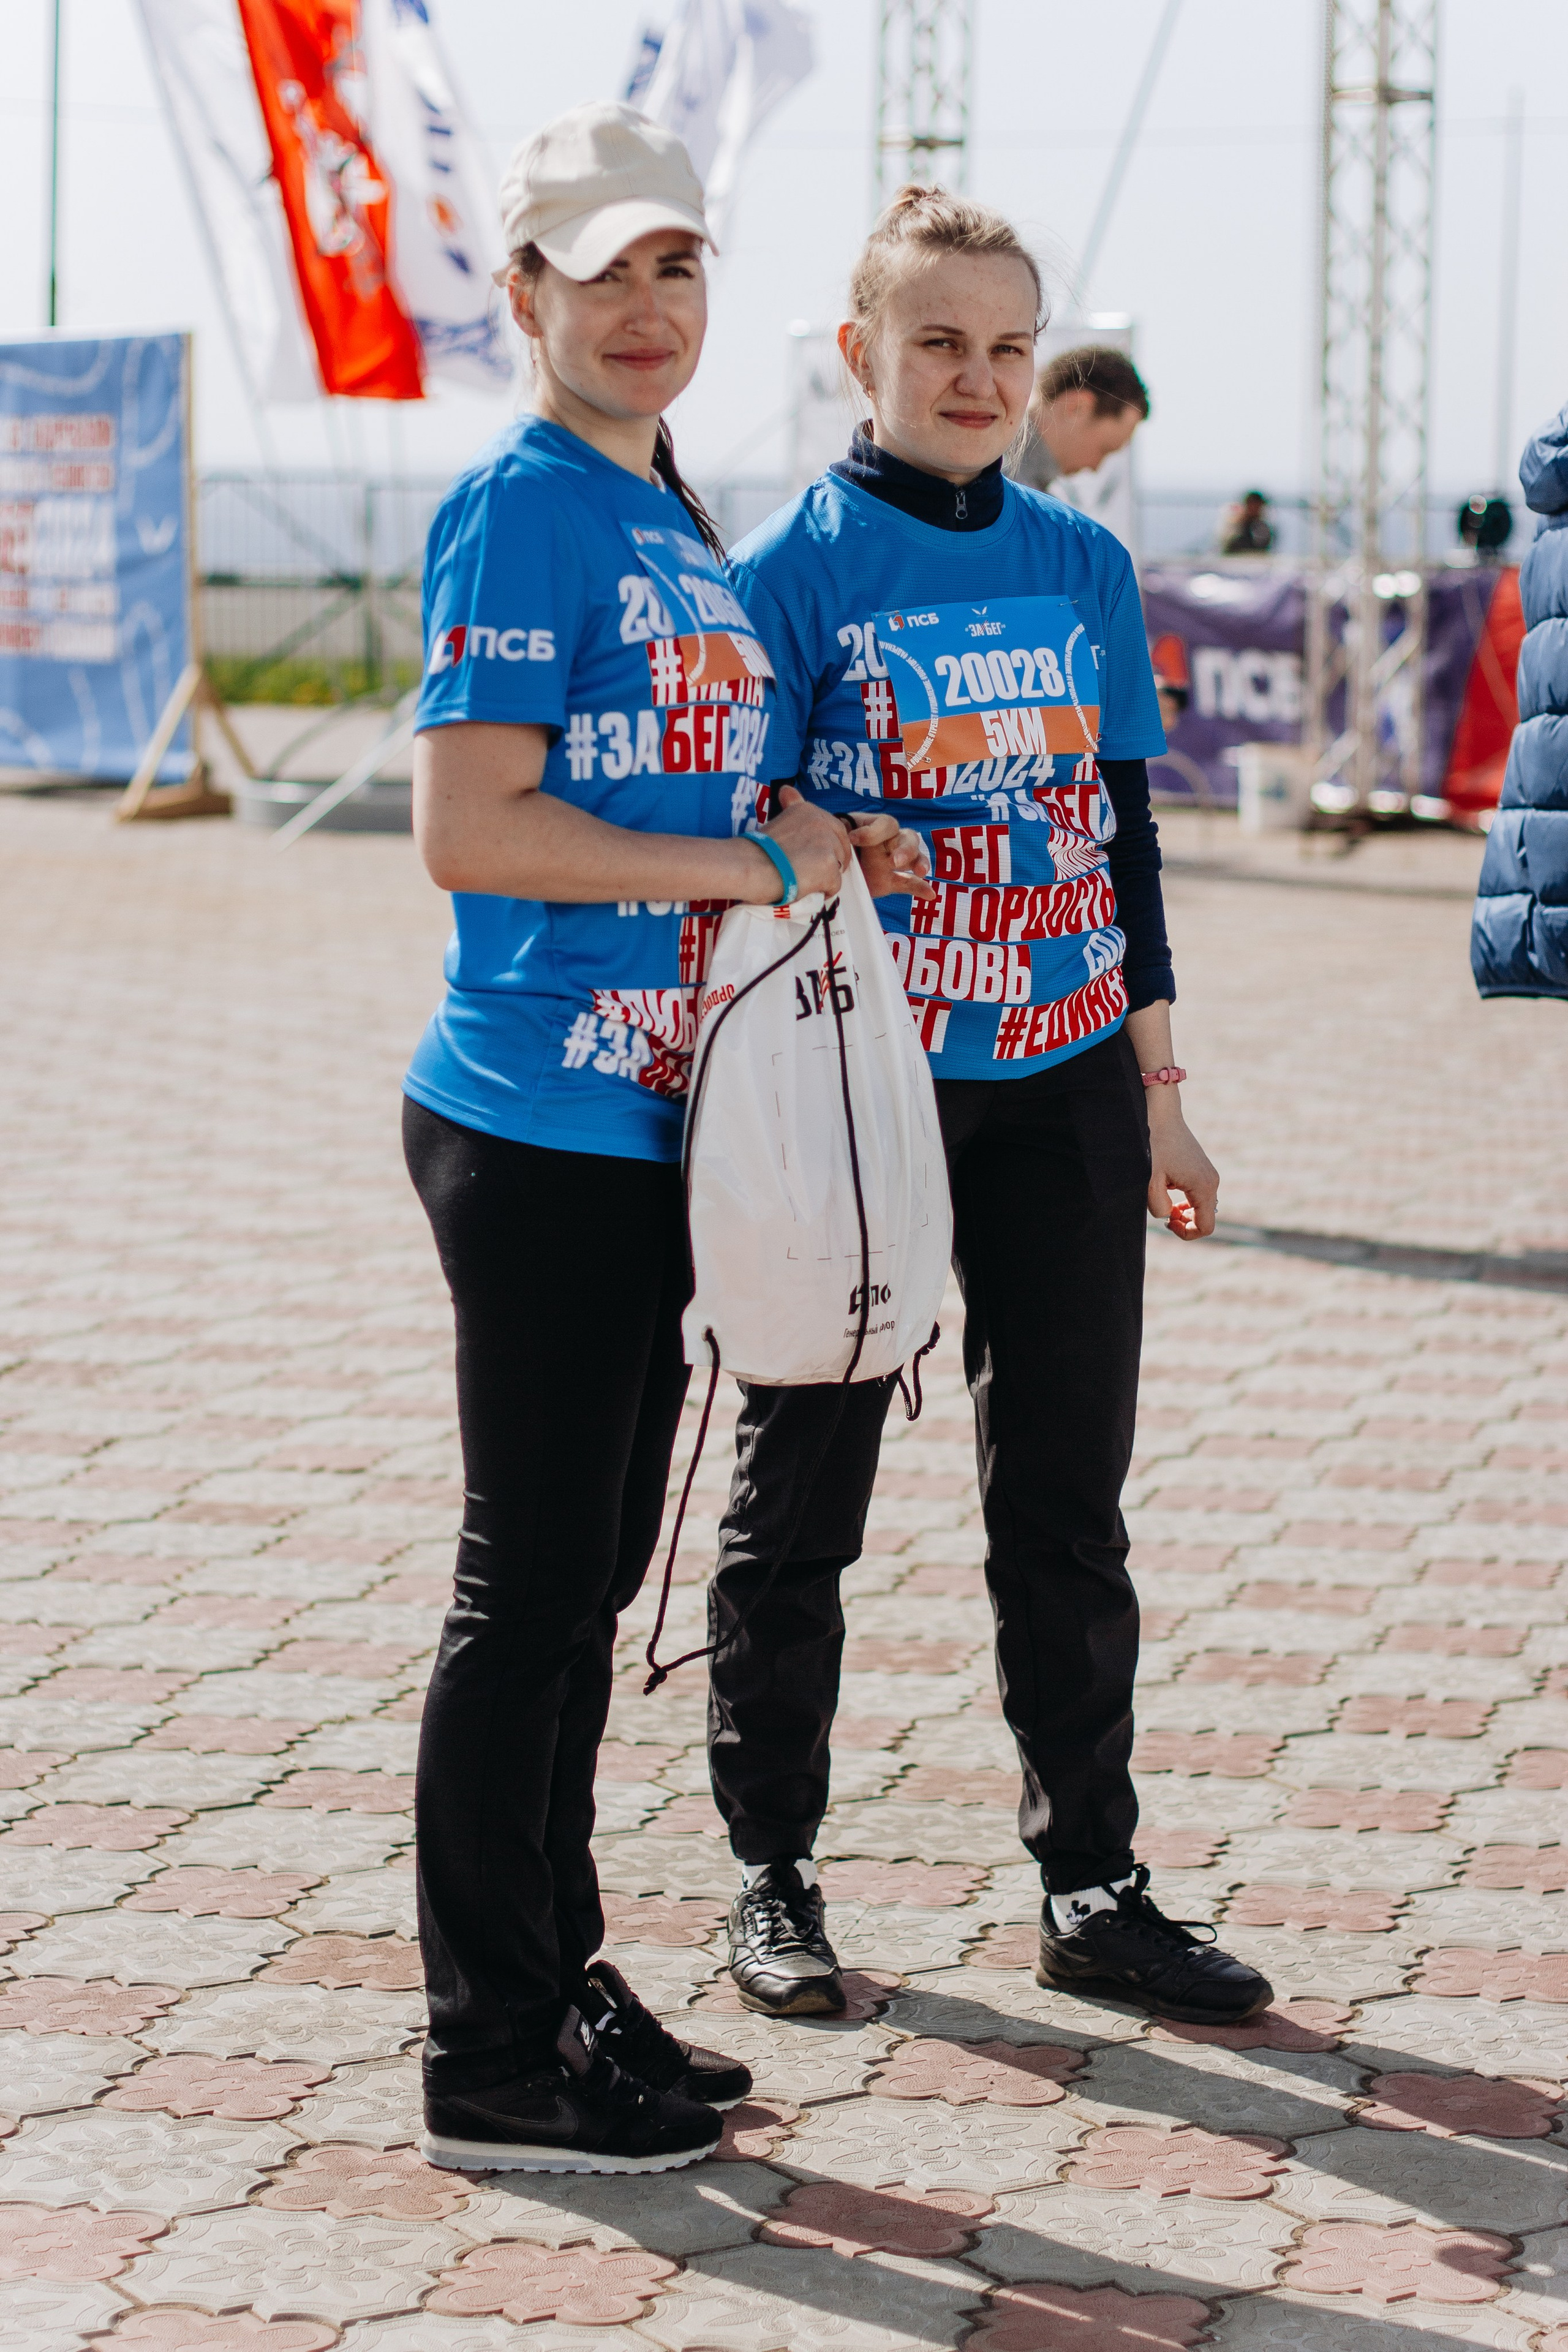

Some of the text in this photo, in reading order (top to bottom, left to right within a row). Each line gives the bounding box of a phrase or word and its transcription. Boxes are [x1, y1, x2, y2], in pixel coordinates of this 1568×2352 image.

[907, 612, 940, 628] ПСБ
[469, 625, 556, 662] ПСБ
[935, 649, 1066, 707] 20028
